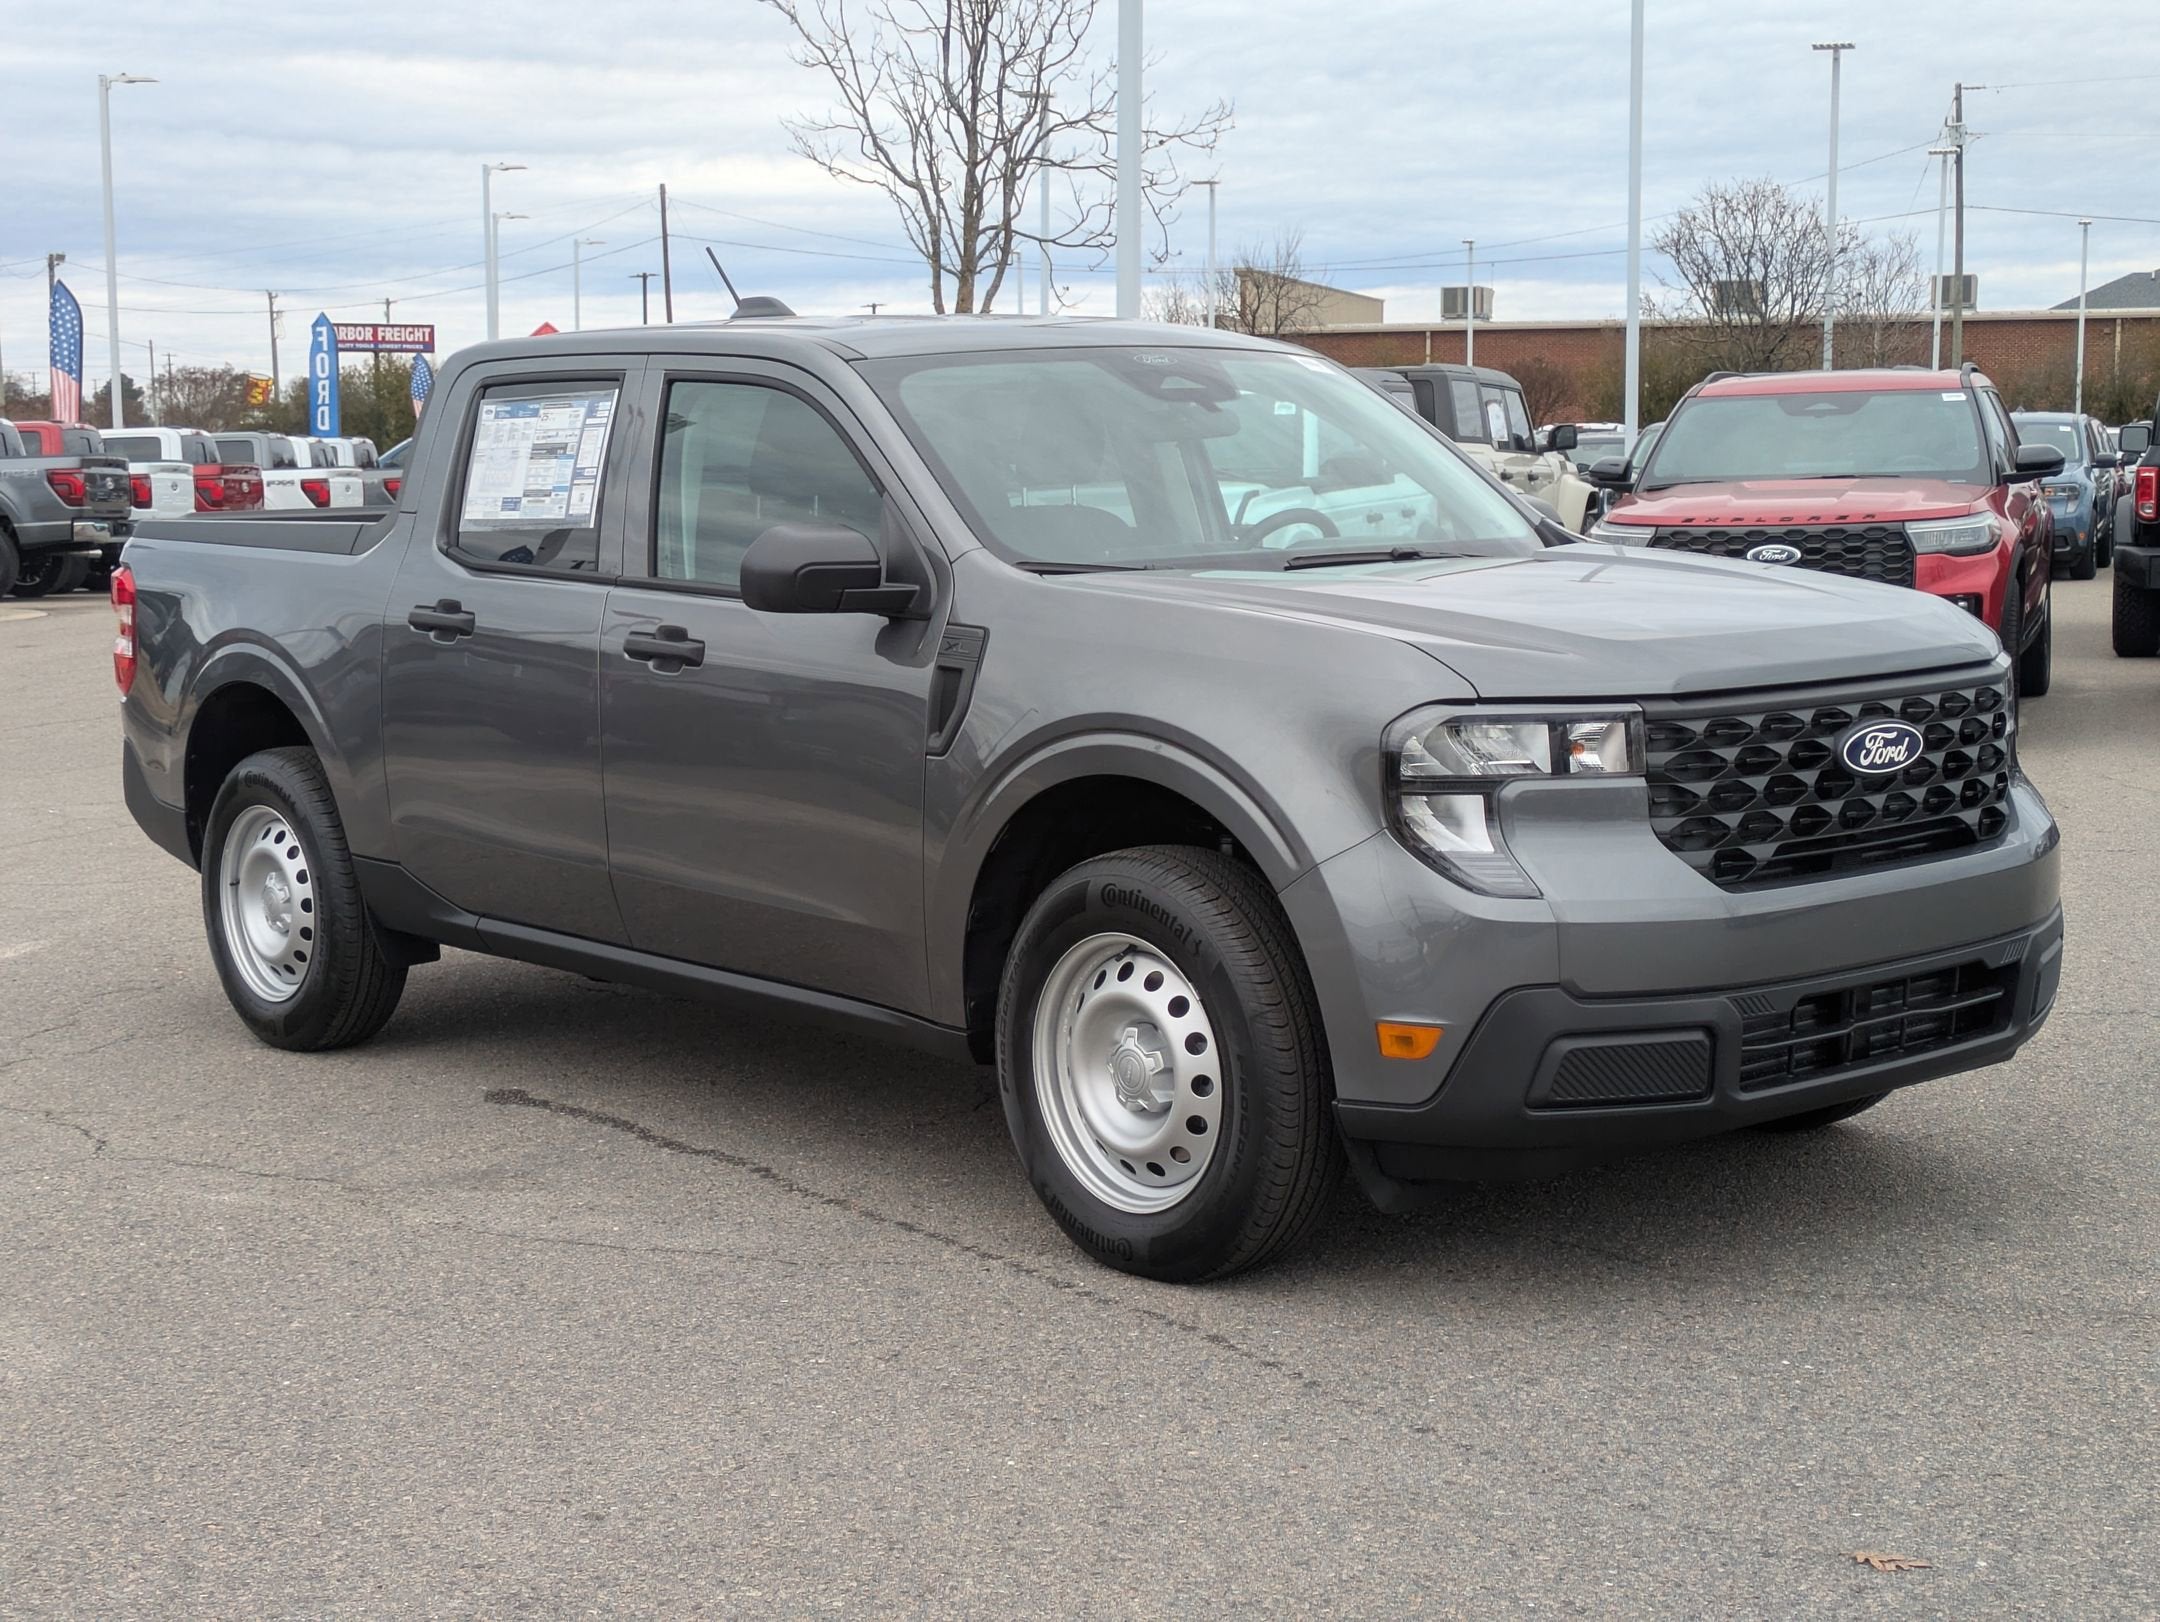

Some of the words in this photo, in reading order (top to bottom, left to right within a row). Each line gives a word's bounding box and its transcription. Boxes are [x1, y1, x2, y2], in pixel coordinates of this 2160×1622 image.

[377, 327, 432, 342] FREIGHT
[1681, 513, 1877, 523] EXPLORER
[1759, 549, 1789, 561] Ford
[1860, 731, 1910, 766] Ford
[1100, 882, 1193, 944] Continental
